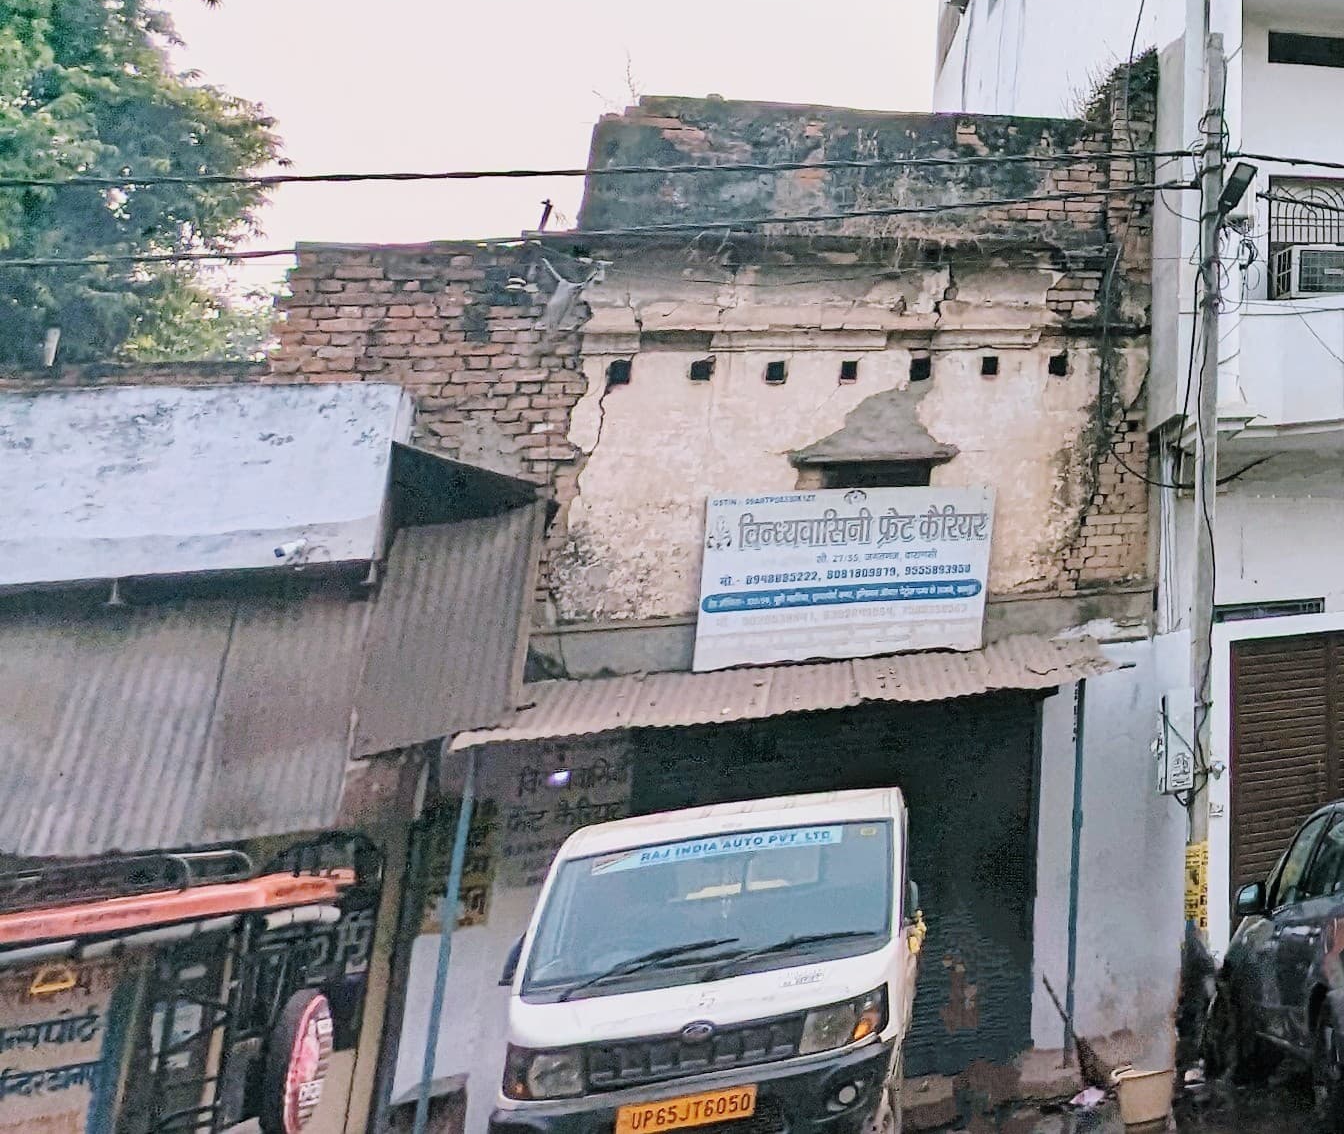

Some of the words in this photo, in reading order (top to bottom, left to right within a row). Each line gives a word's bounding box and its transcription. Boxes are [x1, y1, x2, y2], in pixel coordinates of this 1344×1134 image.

[737, 507, 874, 550] विन्ध्यवासिनी
[876, 507, 916, 546] फ्रेट
[919, 504, 988, 542] कैरियर
[640, 849, 670, 862] RAJ
[675, 842, 718, 857] INDIA
[722, 836, 763, 850] AUTO
[631, 1093, 751, 1131] UP65JT6050
